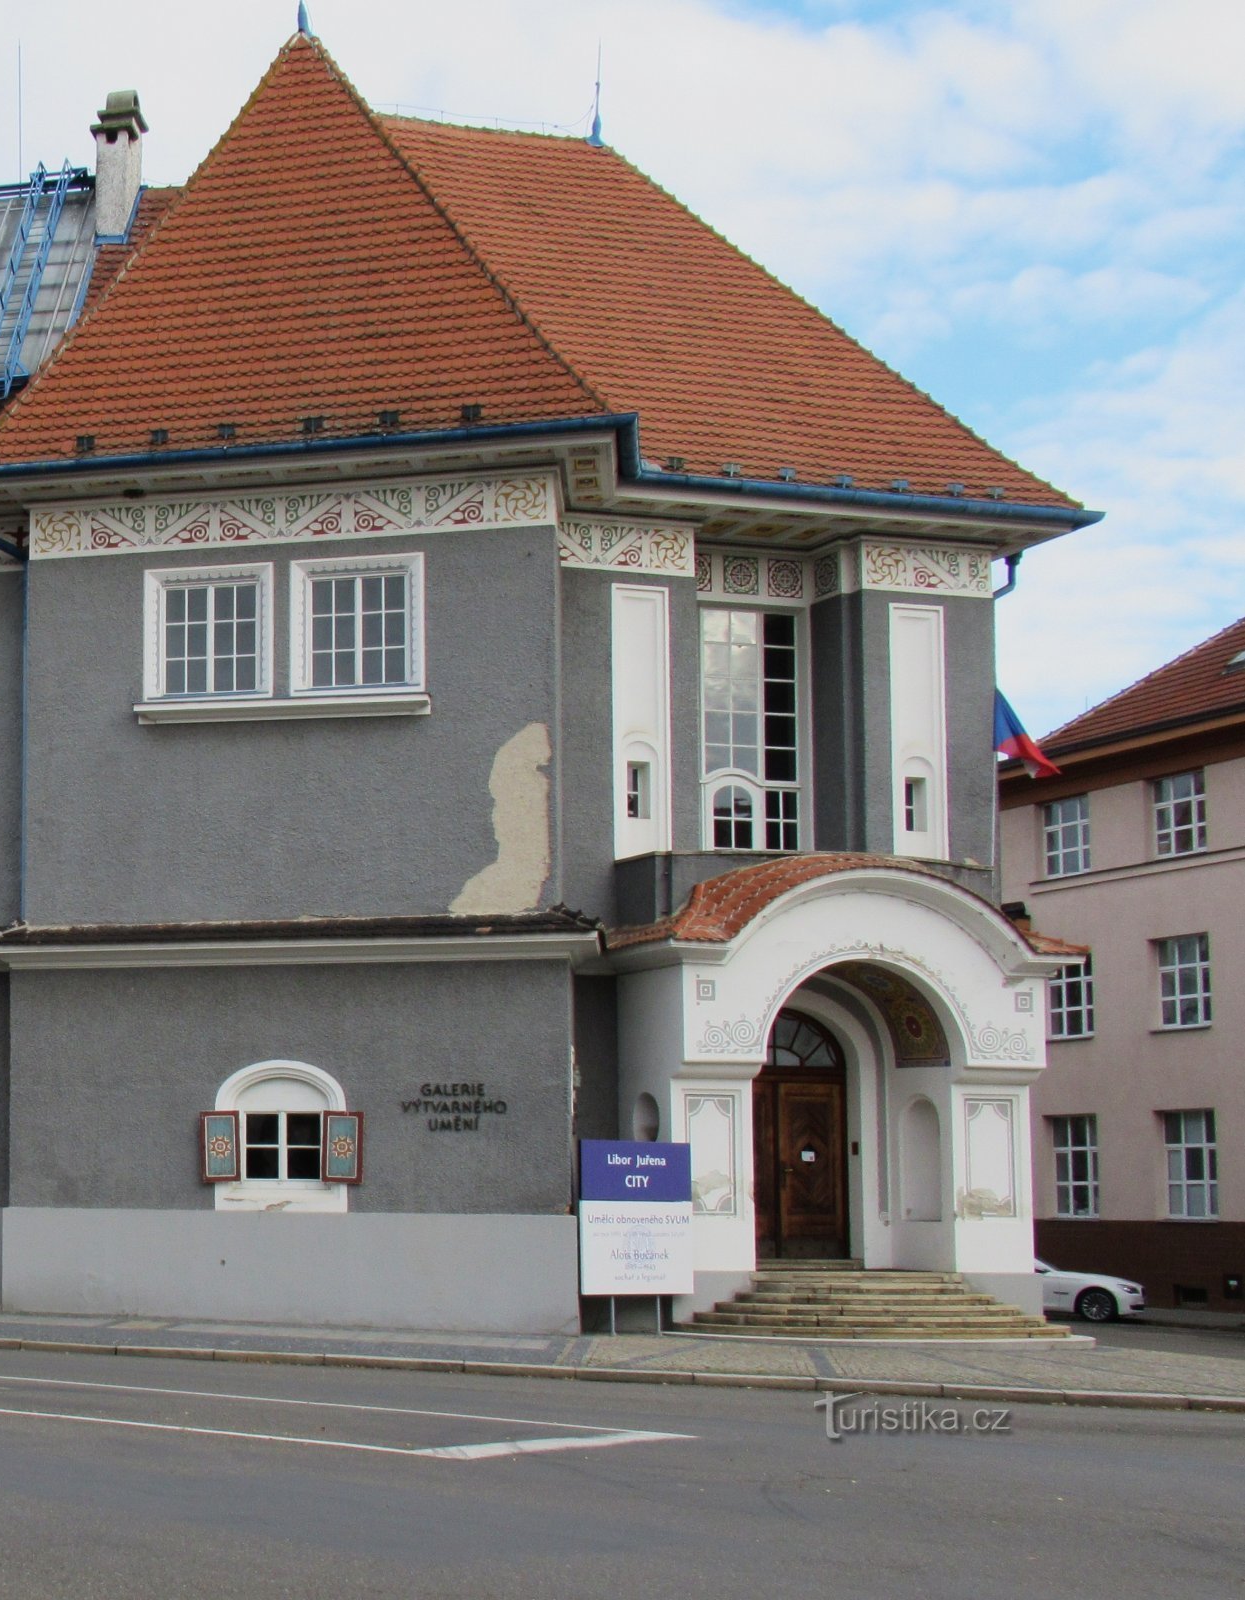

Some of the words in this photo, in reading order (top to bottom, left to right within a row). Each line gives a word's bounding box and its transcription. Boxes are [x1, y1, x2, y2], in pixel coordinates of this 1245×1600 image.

[420, 1083, 486, 1097] GALERIE
[401, 1098, 508, 1114] VÝTVARNÉHO
[428, 1115, 480, 1132] UMĚNÍ
[607, 1154, 631, 1165] Libor
[635, 1154, 667, 1168] Juřena
[625, 1175, 649, 1188] CITY
[587, 1214, 614, 1224] Umělci
[616, 1214, 663, 1225] obnoveného
[665, 1215, 690, 1225] SVUM
